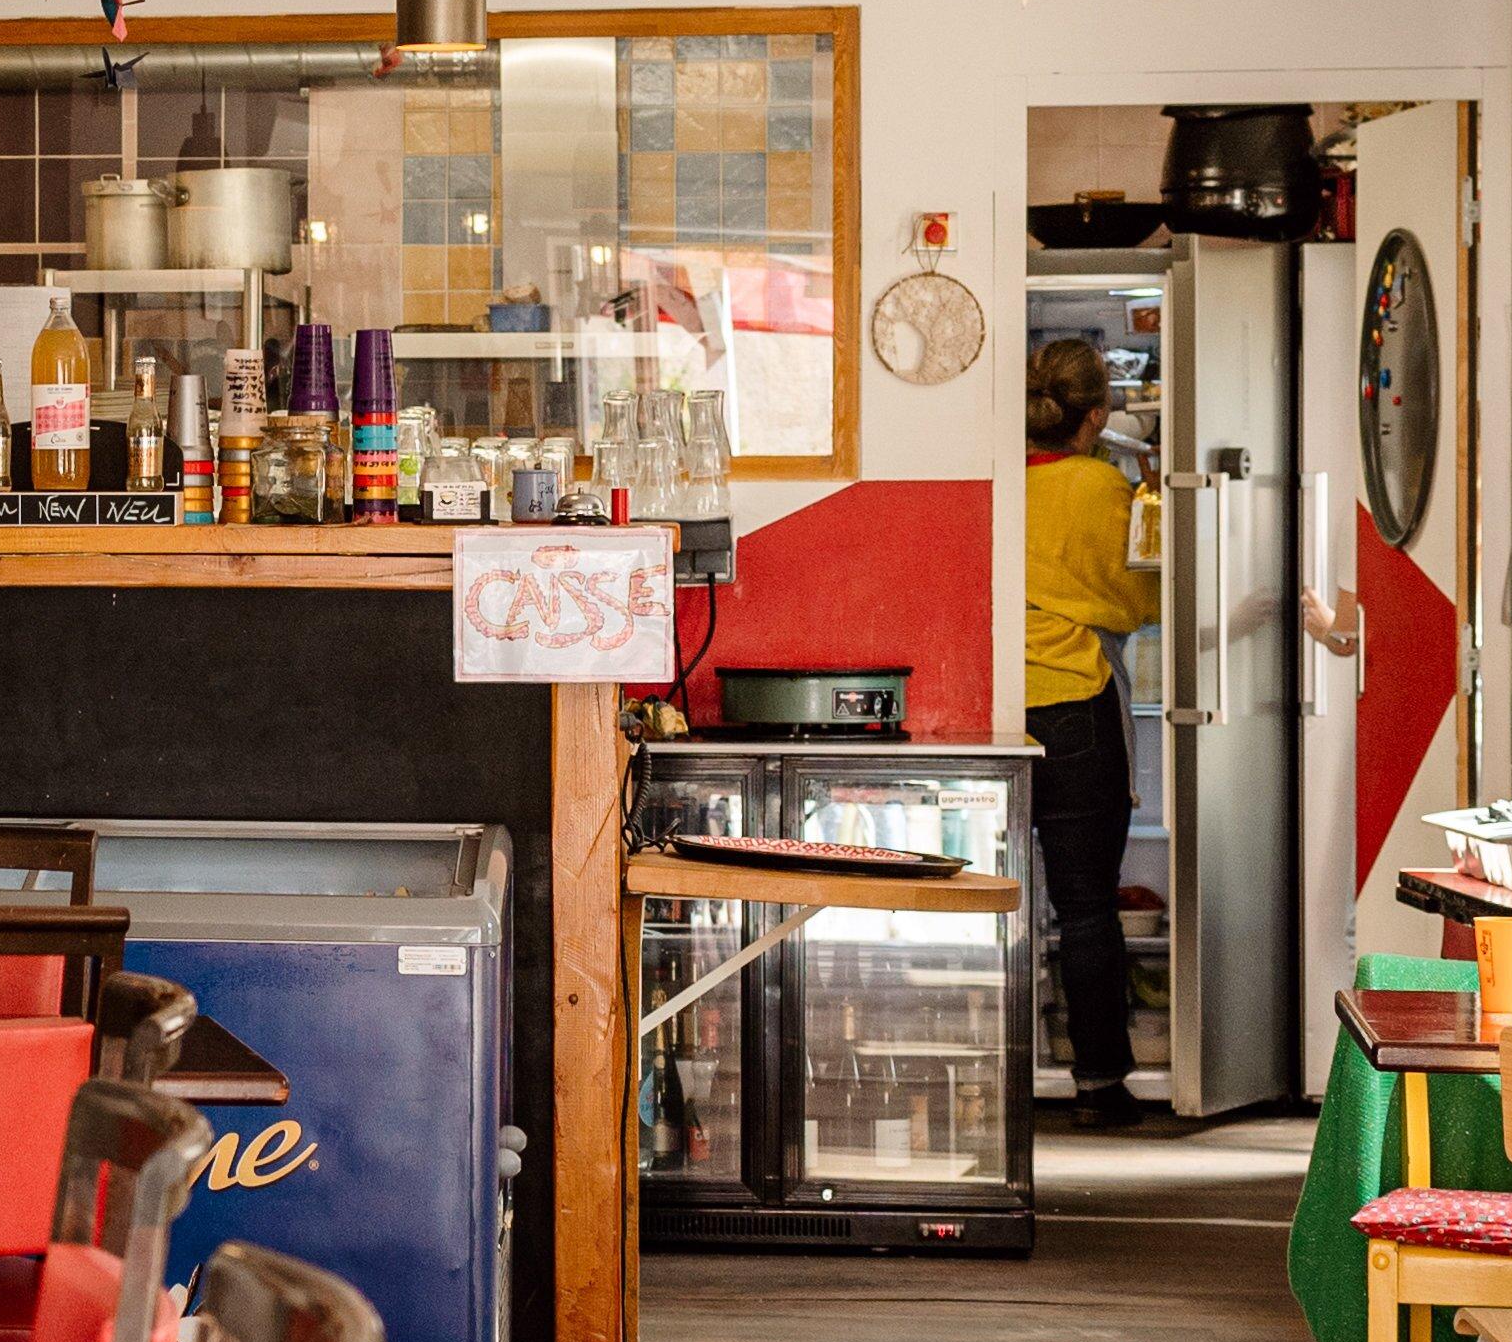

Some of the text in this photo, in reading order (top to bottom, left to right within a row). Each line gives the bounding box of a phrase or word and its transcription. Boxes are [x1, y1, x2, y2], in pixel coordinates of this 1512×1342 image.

[38, 495, 87, 523] NEW
[106, 496, 171, 524] NEU
[465, 545, 670, 652] CAISSE
